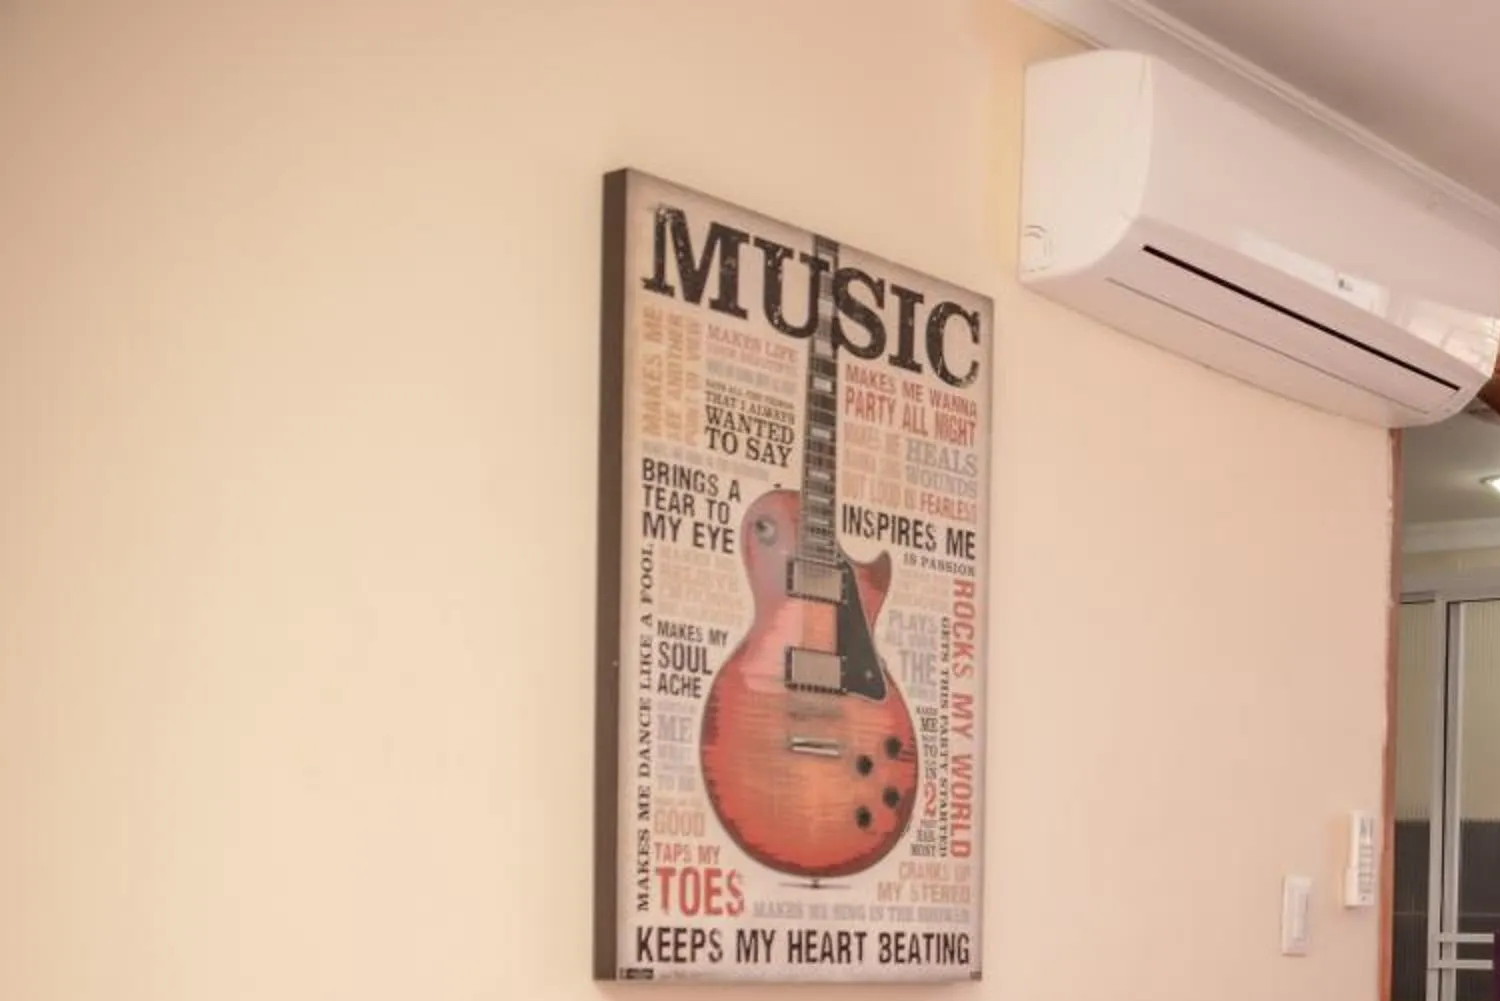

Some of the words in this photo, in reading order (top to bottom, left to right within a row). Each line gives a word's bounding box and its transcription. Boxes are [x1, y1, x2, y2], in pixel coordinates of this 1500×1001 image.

[641, 203, 981, 389] MUSIC
[845, 363, 897, 395] MAKES
[902, 379, 924, 403] ME
[704, 404, 796, 445] WANTED
[845, 385, 897, 428] PARTY
[903, 401, 929, 437] ALL
[934, 410, 977, 447] NIGHT
[704, 425, 740, 455] TO
[745, 436, 794, 468] SAY
[906, 437, 979, 478] HEALS
[642, 456, 721, 497] BRINGS
[728, 479, 741, 503] A
[642, 483, 695, 519] TEAR
[705, 498, 731, 525] TO
[642, 511, 683, 544] MY
[692, 521, 736, 554] EYE
[842, 503, 938, 552] INSPIRES
[945, 527, 977, 561] ME
[640, 542, 655, 604] FOOL
[640, 612, 654, 628] A
[657, 618, 704, 643] MAKES
[708, 627, 729, 648] MY
[953, 578, 976, 680] ROCKS
[639, 633, 653, 690] LIKE
[657, 641, 713, 676] SOUL
[656, 672, 702, 699] ACHE
[638, 697, 652, 778] DANCE
[951, 692, 976, 741] MY
[638, 785, 651, 822] ME
[654, 807, 705, 838] GOOD
[950, 753, 974, 859] WORLD
[637, 830, 651, 913] MAKES
[655, 842, 693, 865] TAPS
[698, 845, 721, 865] MY
[655, 866, 745, 917] TOES
[877, 881, 903, 903] MY
[909, 882, 971, 905] STEREO
[636, 924, 723, 966] KEEPS
[736, 927, 777, 965] MY
[787, 929, 868, 965] HEART
[879, 931, 971, 967] BEATING
